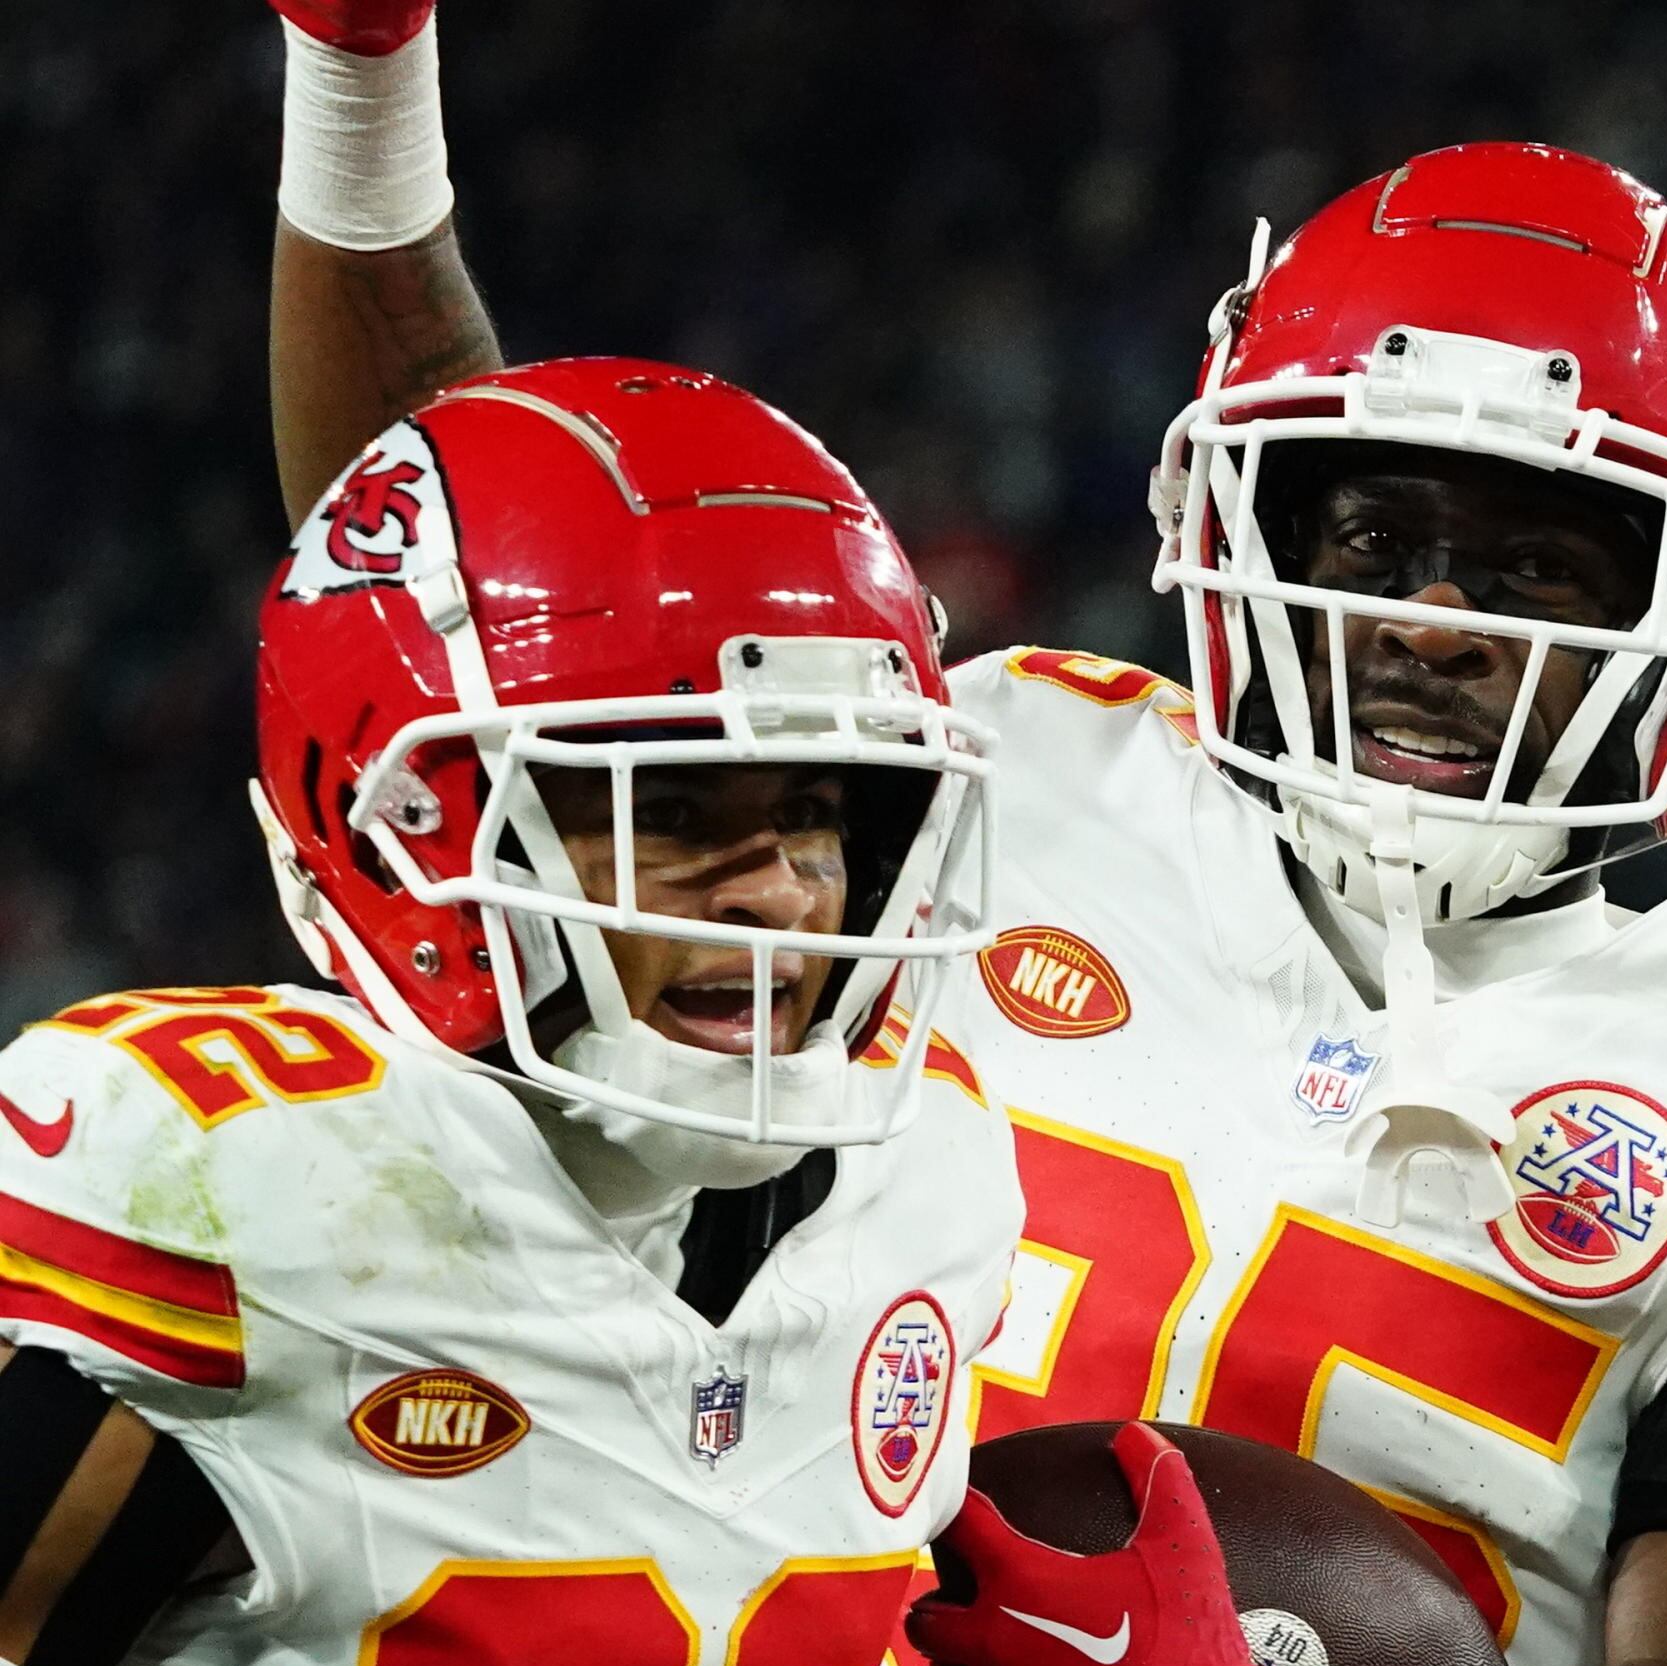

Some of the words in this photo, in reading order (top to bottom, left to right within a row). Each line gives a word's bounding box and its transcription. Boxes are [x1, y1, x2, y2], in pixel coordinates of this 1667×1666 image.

[1009, 946, 1097, 1019] NKH
[1302, 1071, 1348, 1109] NFL
[397, 1396, 488, 1447] NKH
[699, 1410, 737, 1450] NFL
